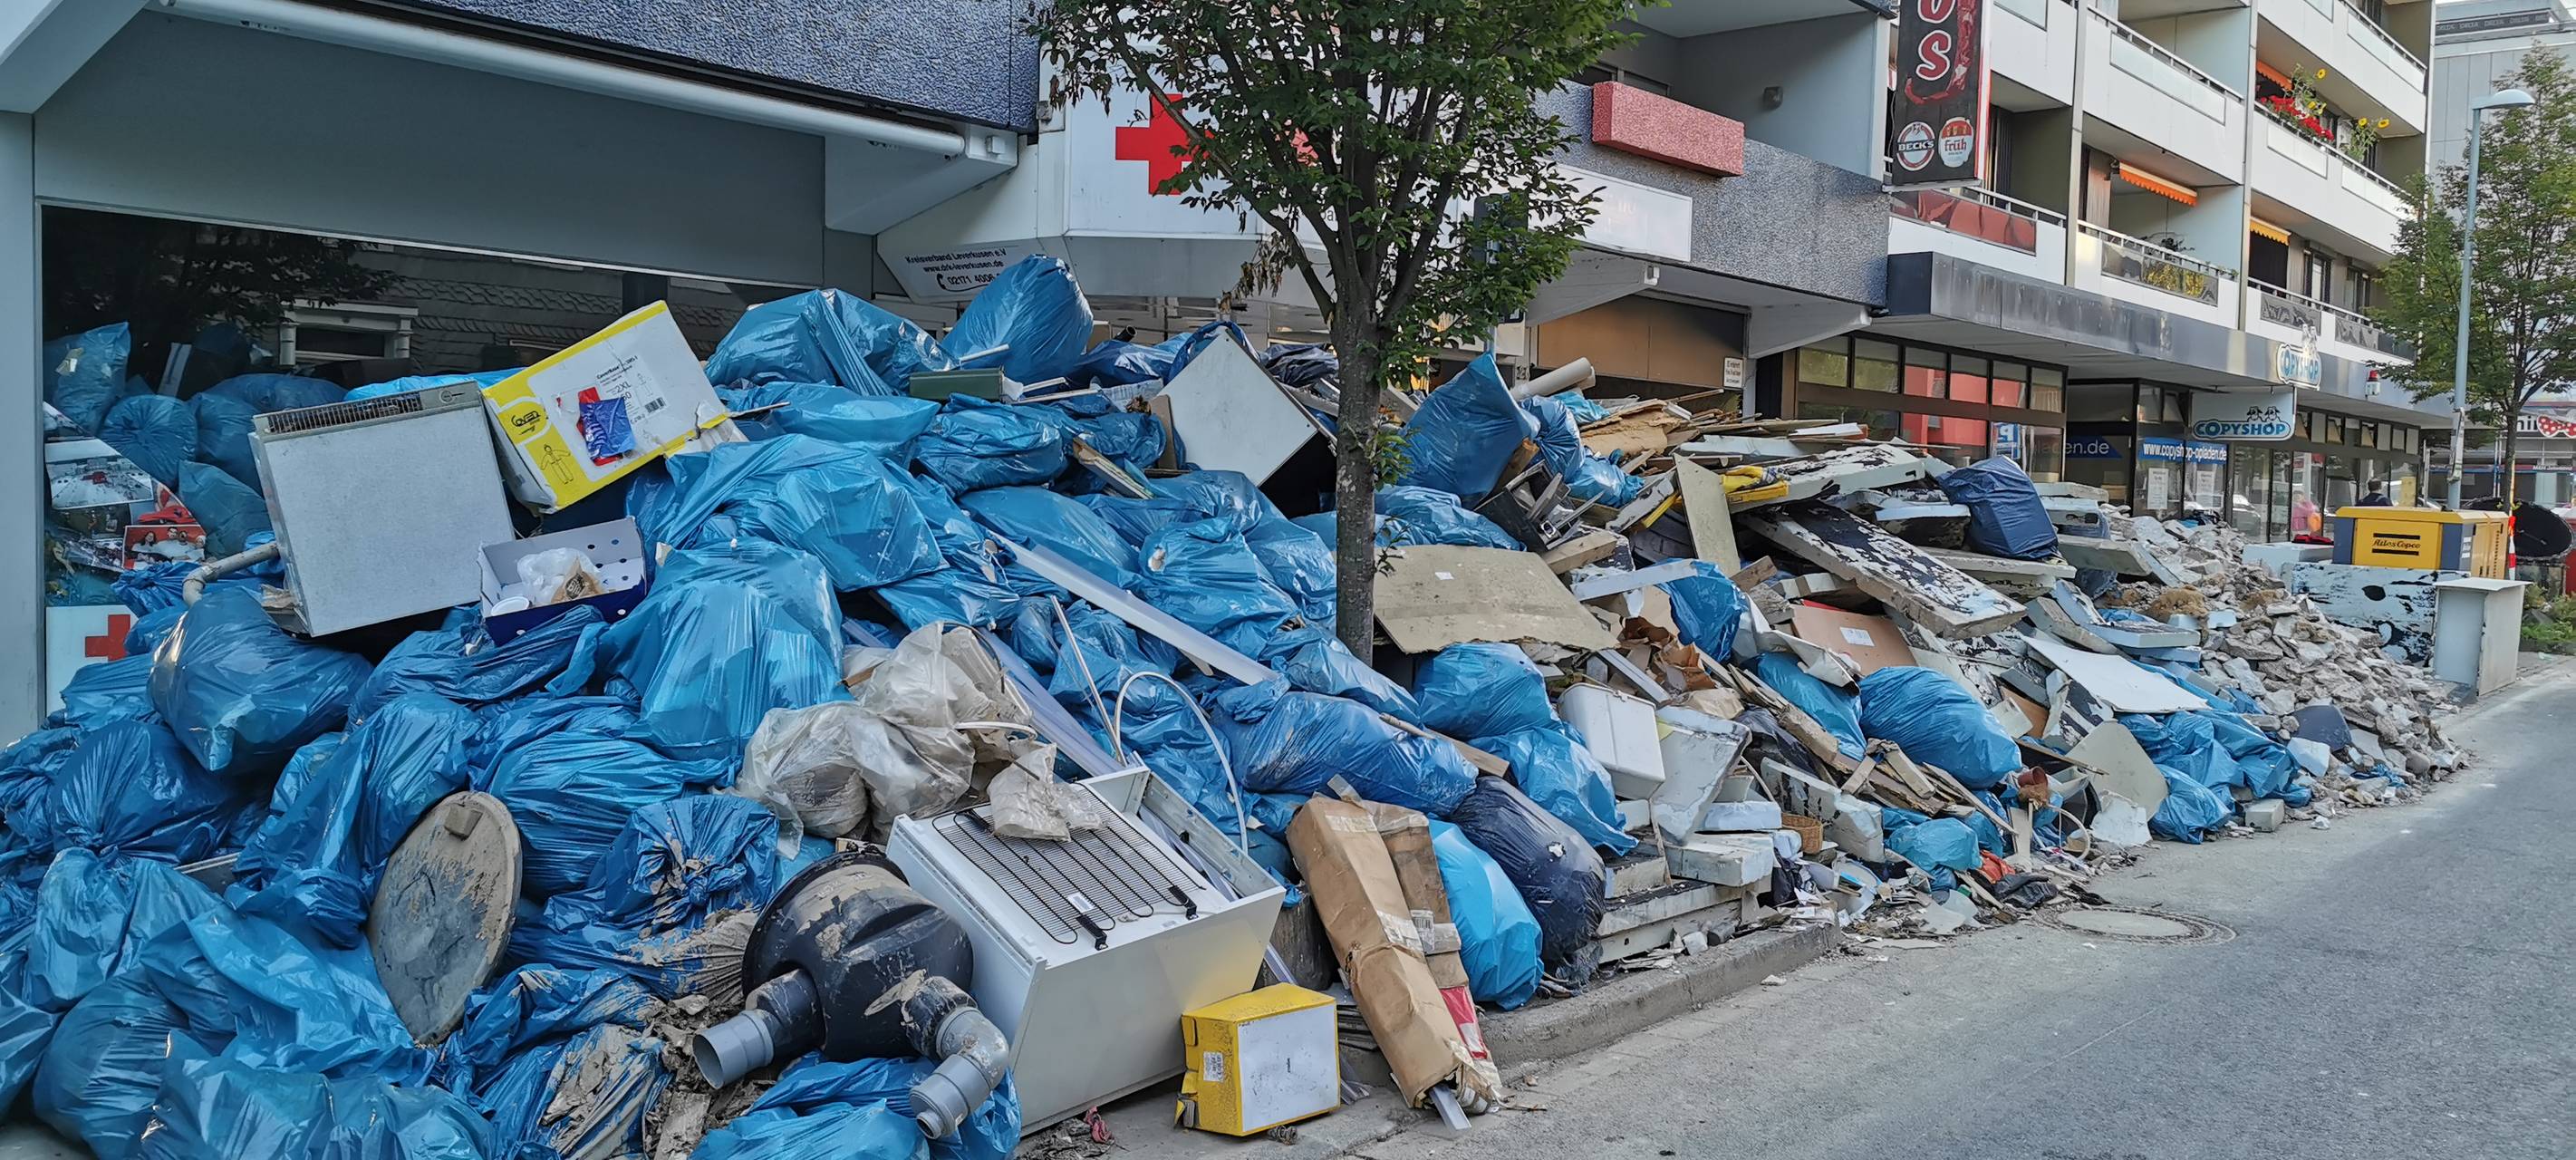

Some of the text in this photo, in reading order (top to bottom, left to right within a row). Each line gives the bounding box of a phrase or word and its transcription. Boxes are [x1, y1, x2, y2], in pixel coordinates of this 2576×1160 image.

[1898, 140, 1934, 152] BECK'S
[1944, 139, 1967, 153] früh
[951, 249, 995, 260] Leverkusen
[947, 275, 972, 285] 02171
[616, 381, 632, 393] 2XL
[2195, 421, 2286, 436] COPYSHOP
[2372, 538, 2421, 549] Atlas Copco
